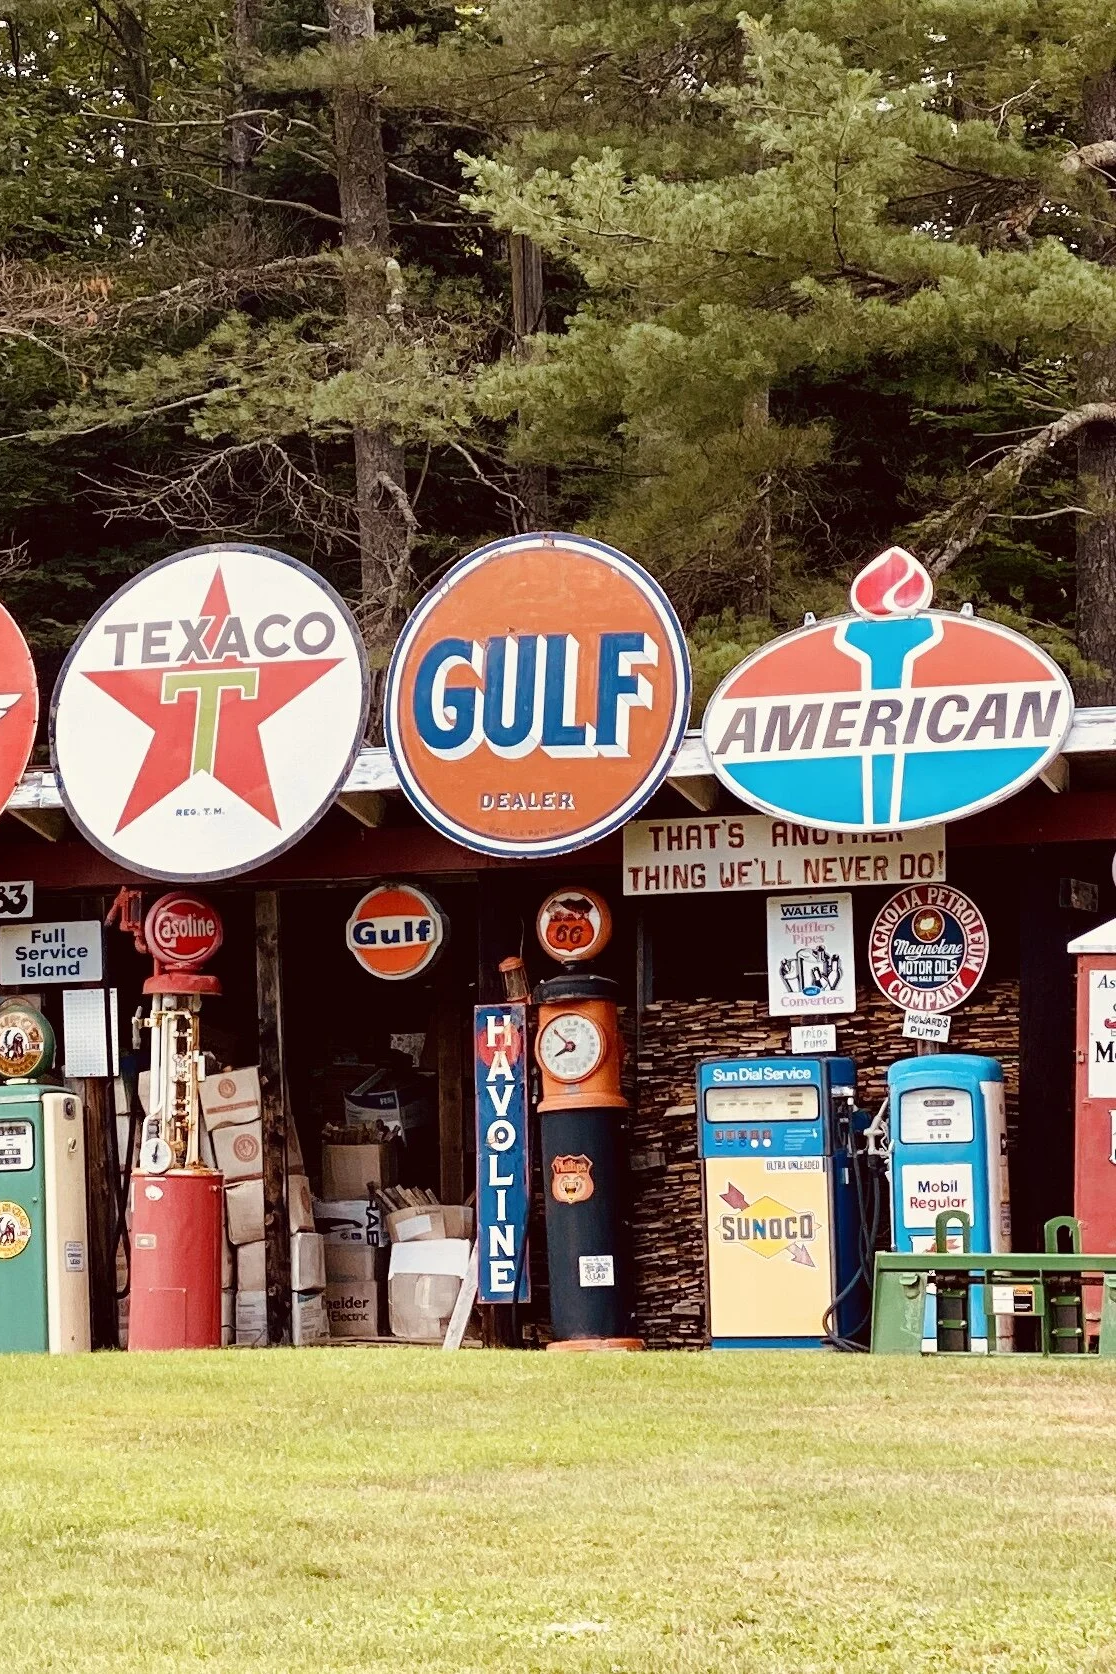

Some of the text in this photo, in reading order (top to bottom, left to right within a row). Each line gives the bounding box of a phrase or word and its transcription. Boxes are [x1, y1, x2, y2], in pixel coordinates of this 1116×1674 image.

[103, 612, 336, 667] TEXACO
[412, 631, 658, 761] GULF
[161, 667, 259, 777] T
[714, 689, 1062, 755] AMERICAN
[480, 791, 576, 811] DEALER
[648, 819, 745, 852] THAT'S
[628, 850, 945, 893] THING WE'LL NEVER DO!
[780, 904, 839, 917] WALKER
[31, 928, 65, 943] Full
[155, 911, 215, 948] Gasoline
[353, 919, 431, 945] Gulf
[555, 924, 584, 945] 66
[785, 921, 836, 934] Mufflers
[928, 887, 985, 973] PETROLEUM
[792, 934, 825, 947] Pipes
[893, 938, 964, 961] Magnolene
[15, 944, 88, 960] Service
[21, 961, 80, 978] Island
[899, 960, 958, 974] MOTOR OILS
[781, 995, 845, 1008] Converters
[888, 980, 969, 1010] COMPANY
[908, 1014, 948, 1028] HOWARD'S
[910, 1026, 941, 1038] PUMP
[803, 1039, 828, 1049] PUMP
[713, 1067, 811, 1082] Sun Dial Service
[485, 1015, 516, 1294] HAVOLINE
[918, 1180, 958, 1194] Mobil
[909, 1196, 966, 1211] Regular
[720, 1213, 816, 1242] SUNOCO
